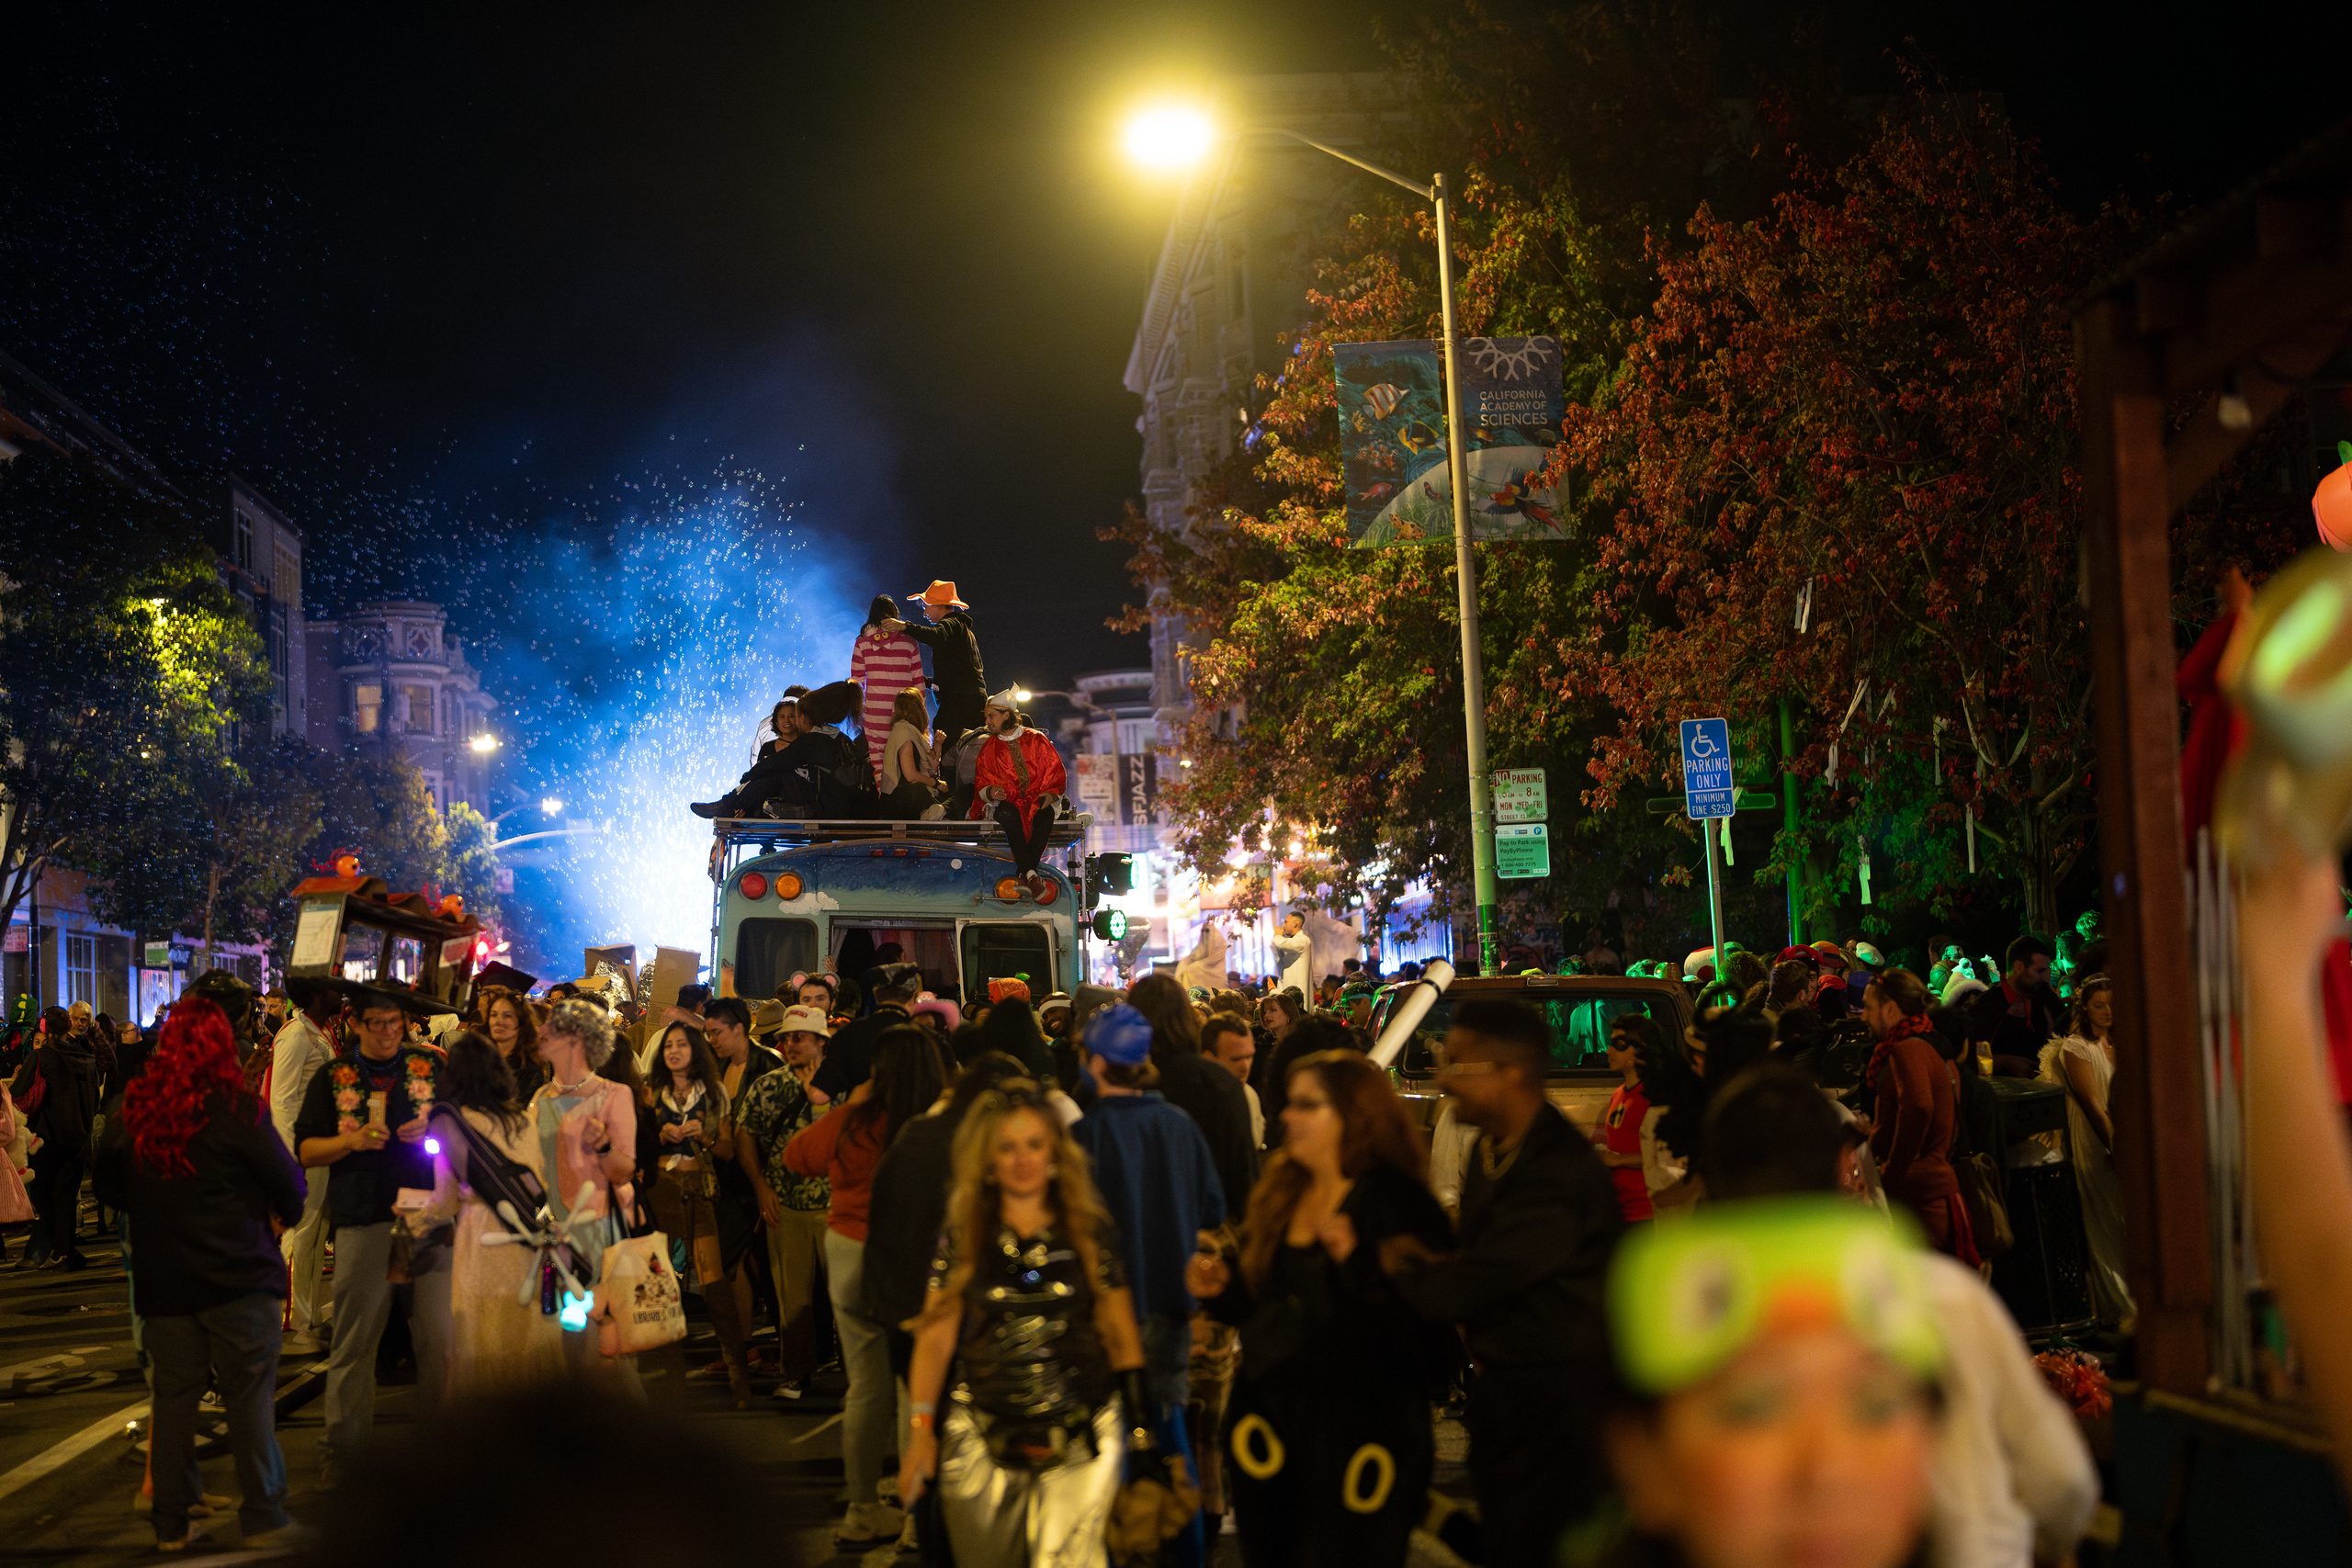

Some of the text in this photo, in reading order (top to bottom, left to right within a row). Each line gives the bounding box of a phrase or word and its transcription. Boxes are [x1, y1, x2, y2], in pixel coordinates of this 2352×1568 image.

[1479, 389, 1546, 400] CALIFORNIA
[1479, 400, 1547, 412] ACADEMY OF
[1480, 412, 1548, 426] SCIENCES
[1686, 757, 1728, 773] PARKING
[1496, 772, 1543, 787] NO PARKING
[1696, 773, 1721, 789] ONLY
[1130, 755, 1148, 826] SFJAZZ
[1695, 792, 1725, 804] MINIMUM
[1499, 802, 1513, 811] MON
[1532, 800, 1543, 809] FRI
[1691, 805, 1708, 816] FINE
[1711, 803, 1731, 815] $250
[1499, 847, 1533, 855] PayByPhone
